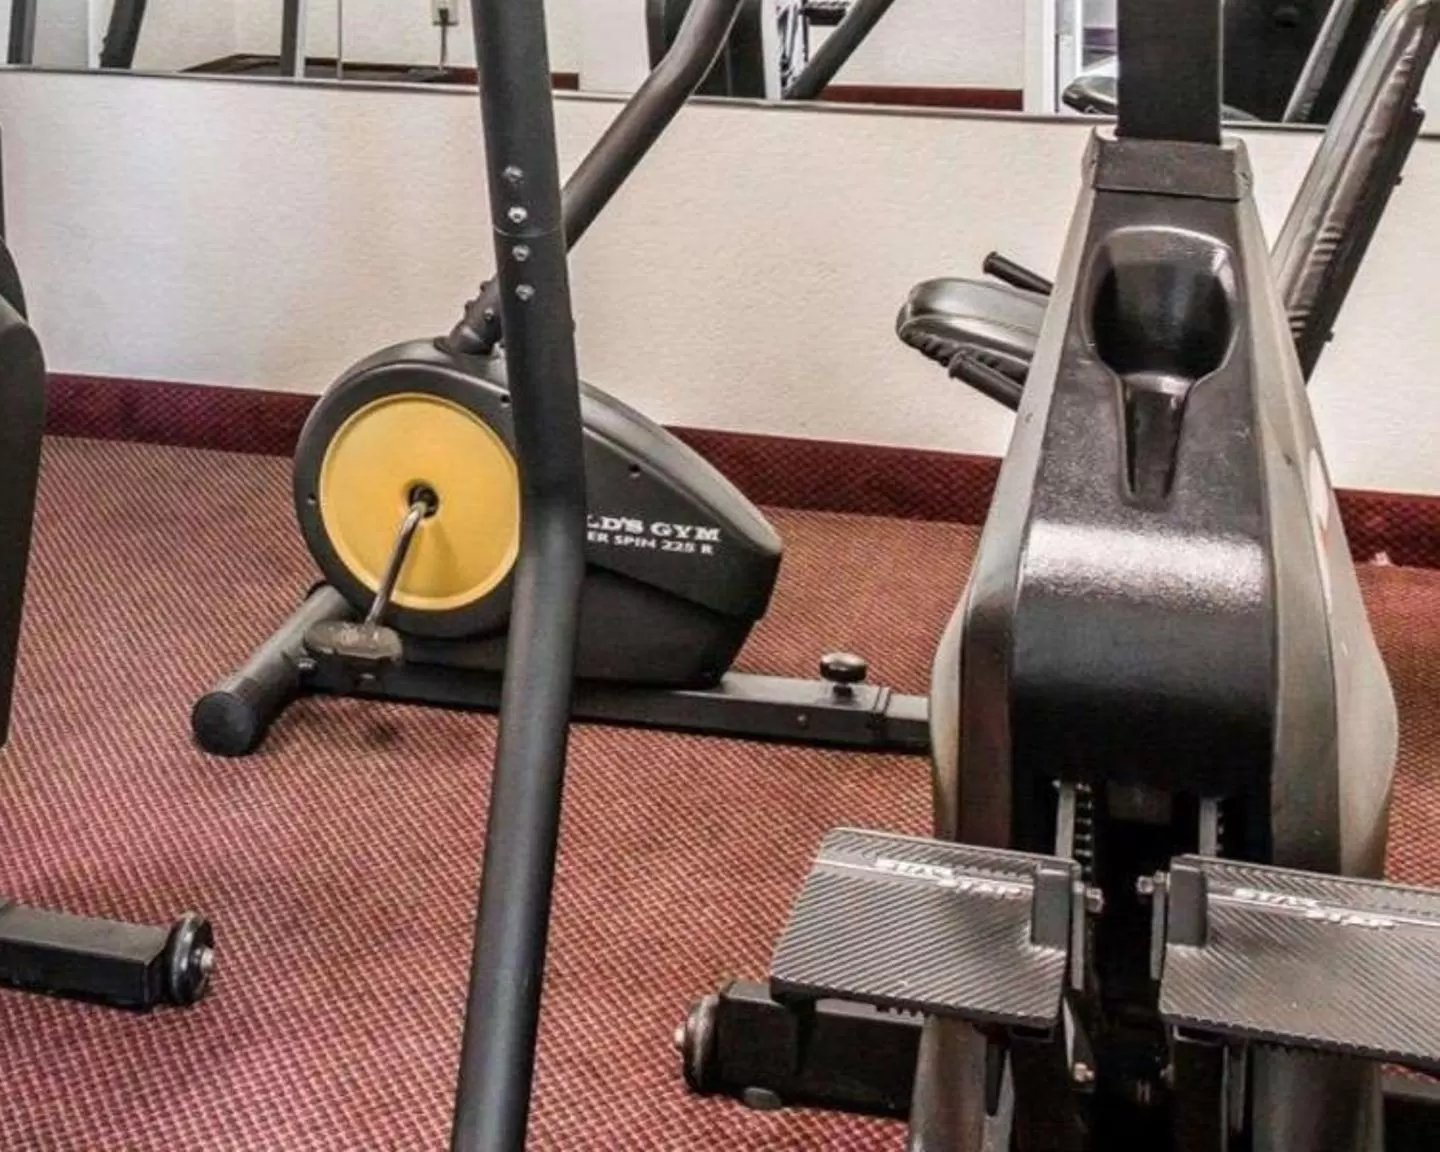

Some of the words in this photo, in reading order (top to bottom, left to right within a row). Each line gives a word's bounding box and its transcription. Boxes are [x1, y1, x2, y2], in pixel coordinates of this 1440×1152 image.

[650, 521, 721, 542] GYM
[613, 534, 656, 549] SPIN
[661, 539, 695, 554] 225
[699, 543, 714, 555] R
